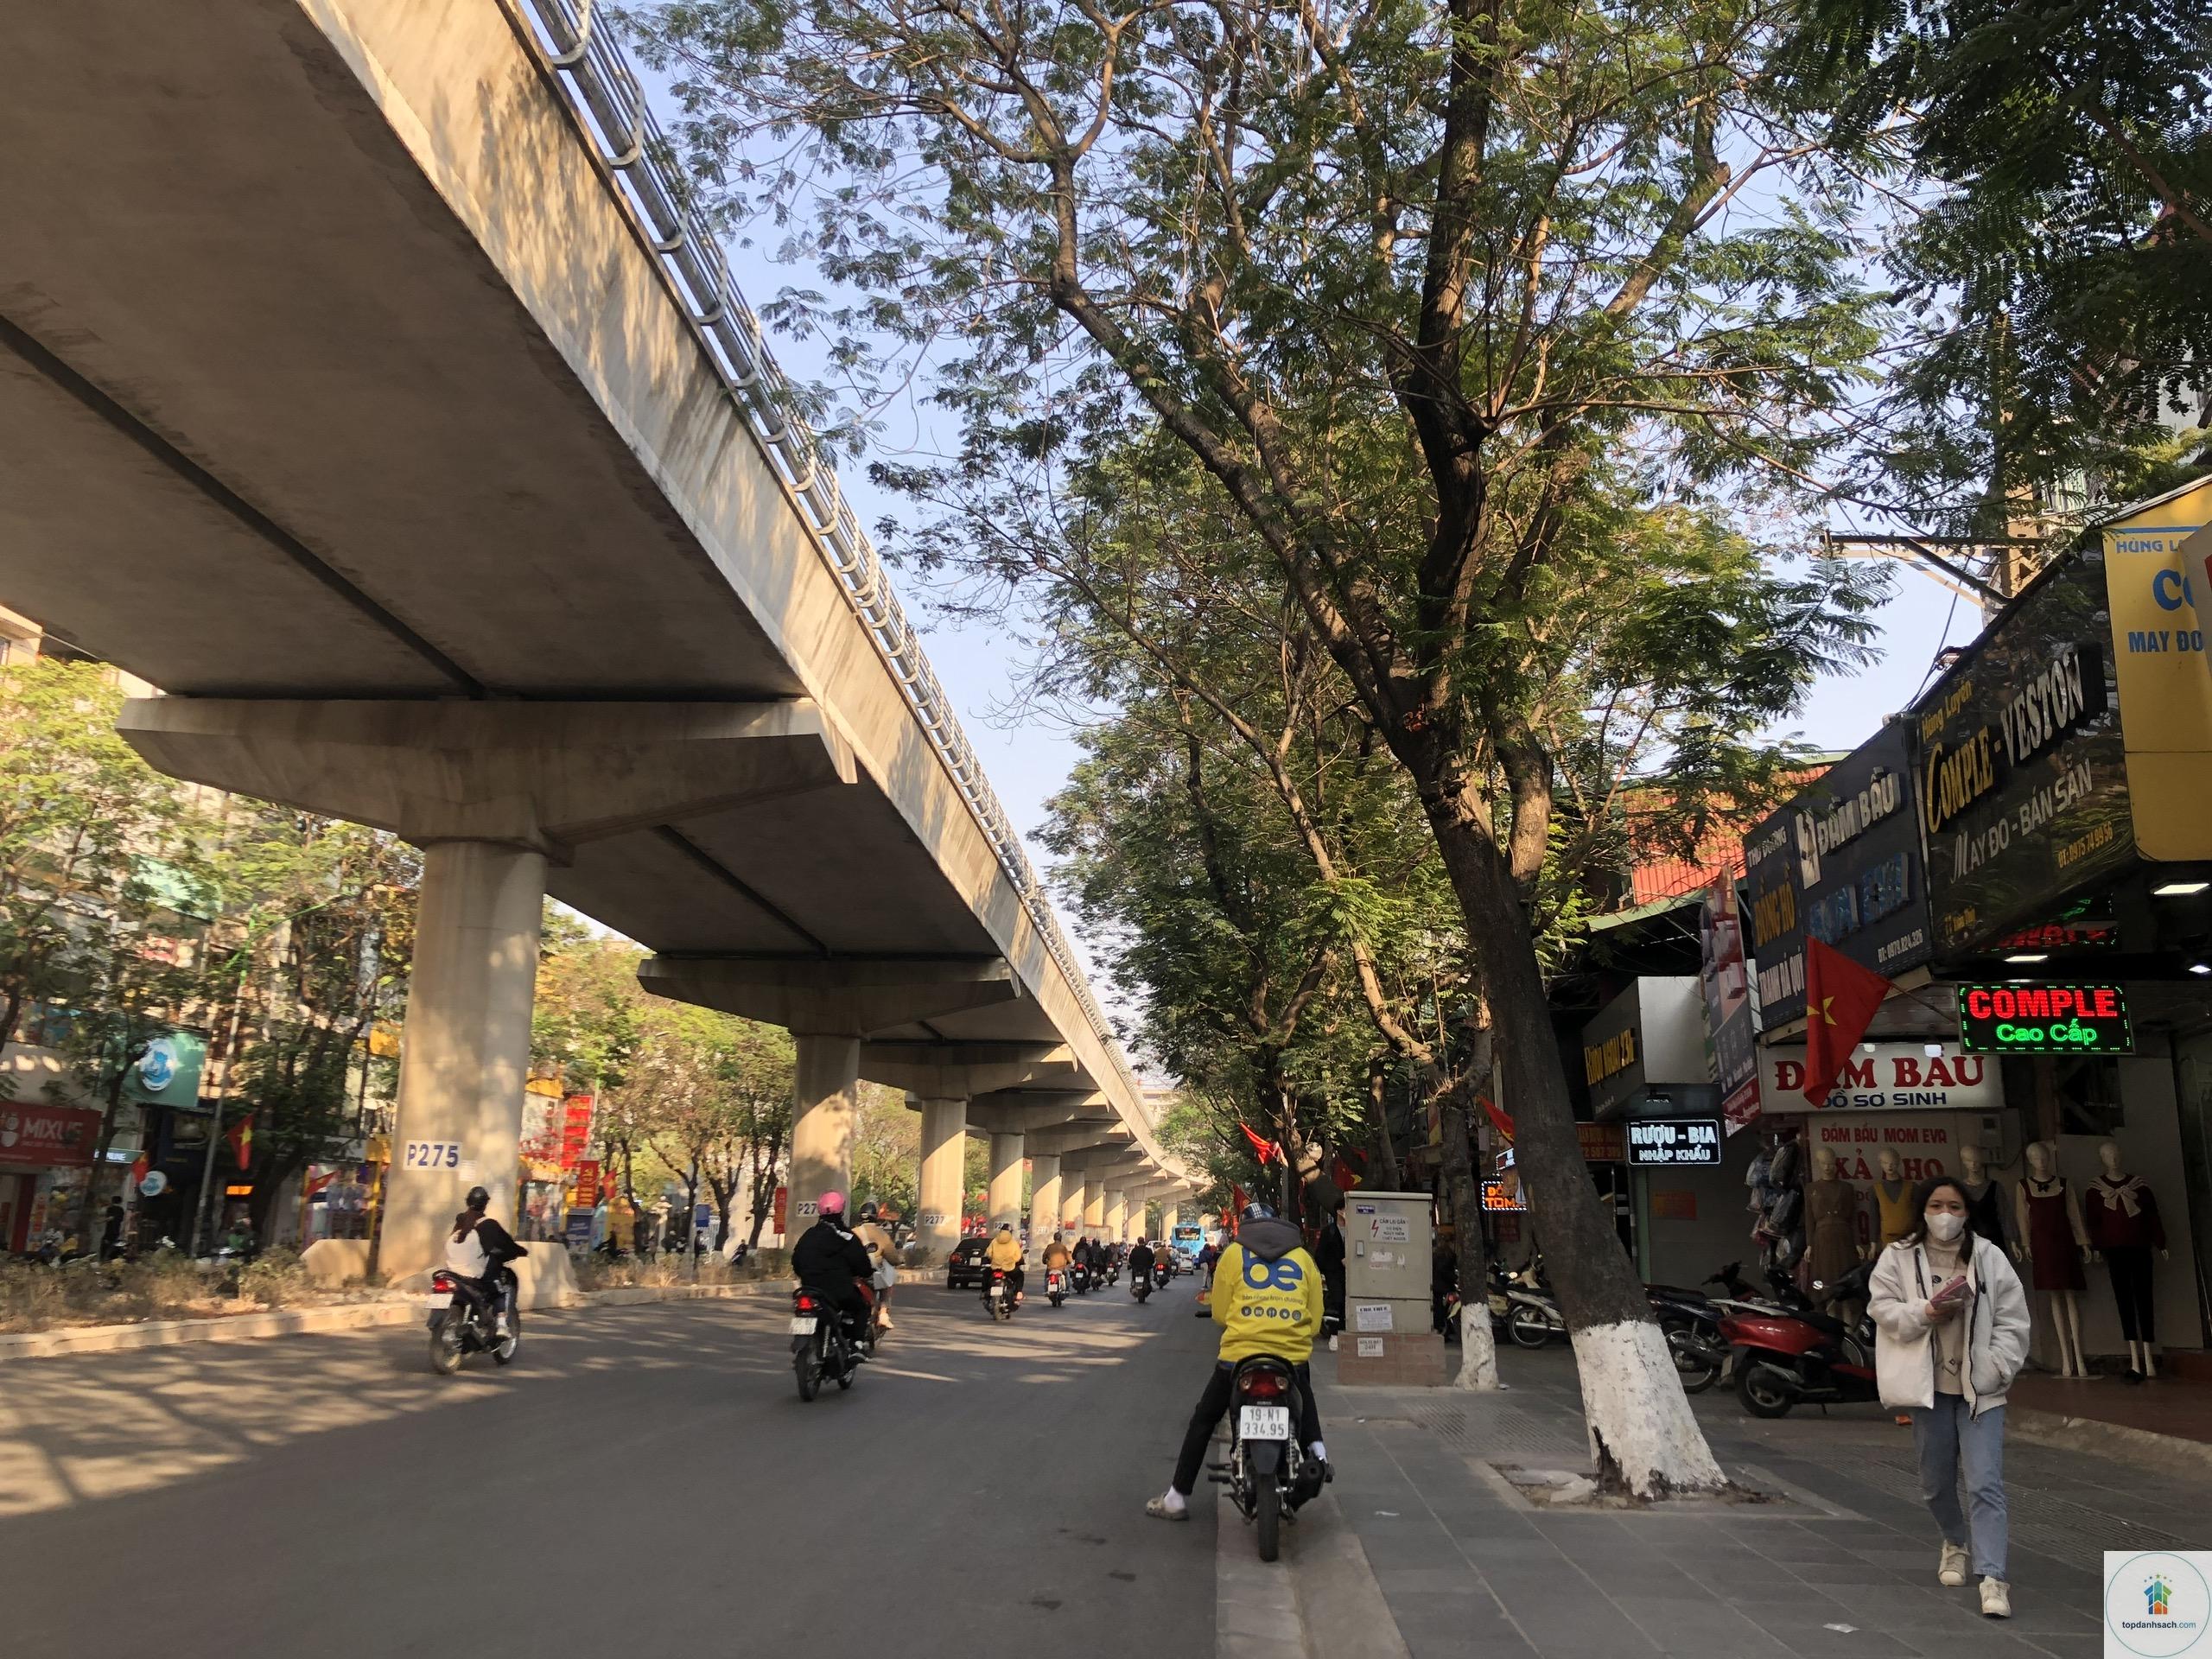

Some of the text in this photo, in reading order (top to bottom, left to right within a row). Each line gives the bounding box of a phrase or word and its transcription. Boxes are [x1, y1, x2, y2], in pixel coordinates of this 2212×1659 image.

[2116, 537, 2163, 554] HÙNG
[2127, 632, 2170, 652] MAY
[2018, 785, 2054, 837] BÁN
[1968, 989, 2118, 1019] COMPLE
[1996, 1019, 2098, 1046] Cao Cấp
[1775, 1058, 1878, 1091] ĐM
[1853, 1091, 1885, 1108] SƠ
[1893, 1091, 1947, 1107] SINH
[1630, 1124, 1676, 1147] RƯỢU
[1688, 1126, 1717, 1144] BIA
[1884, 1128, 1919, 1143] MOM
[1923, 1128, 1948, 1144] EVA
[407, 1143, 459, 1168] P275
[1638, 1147, 1674, 1163] NHẬP
[1882, 1157, 1945, 1181] HO
[798, 1203, 818, 1215] P27
[1242, 1246, 1303, 1291] be
